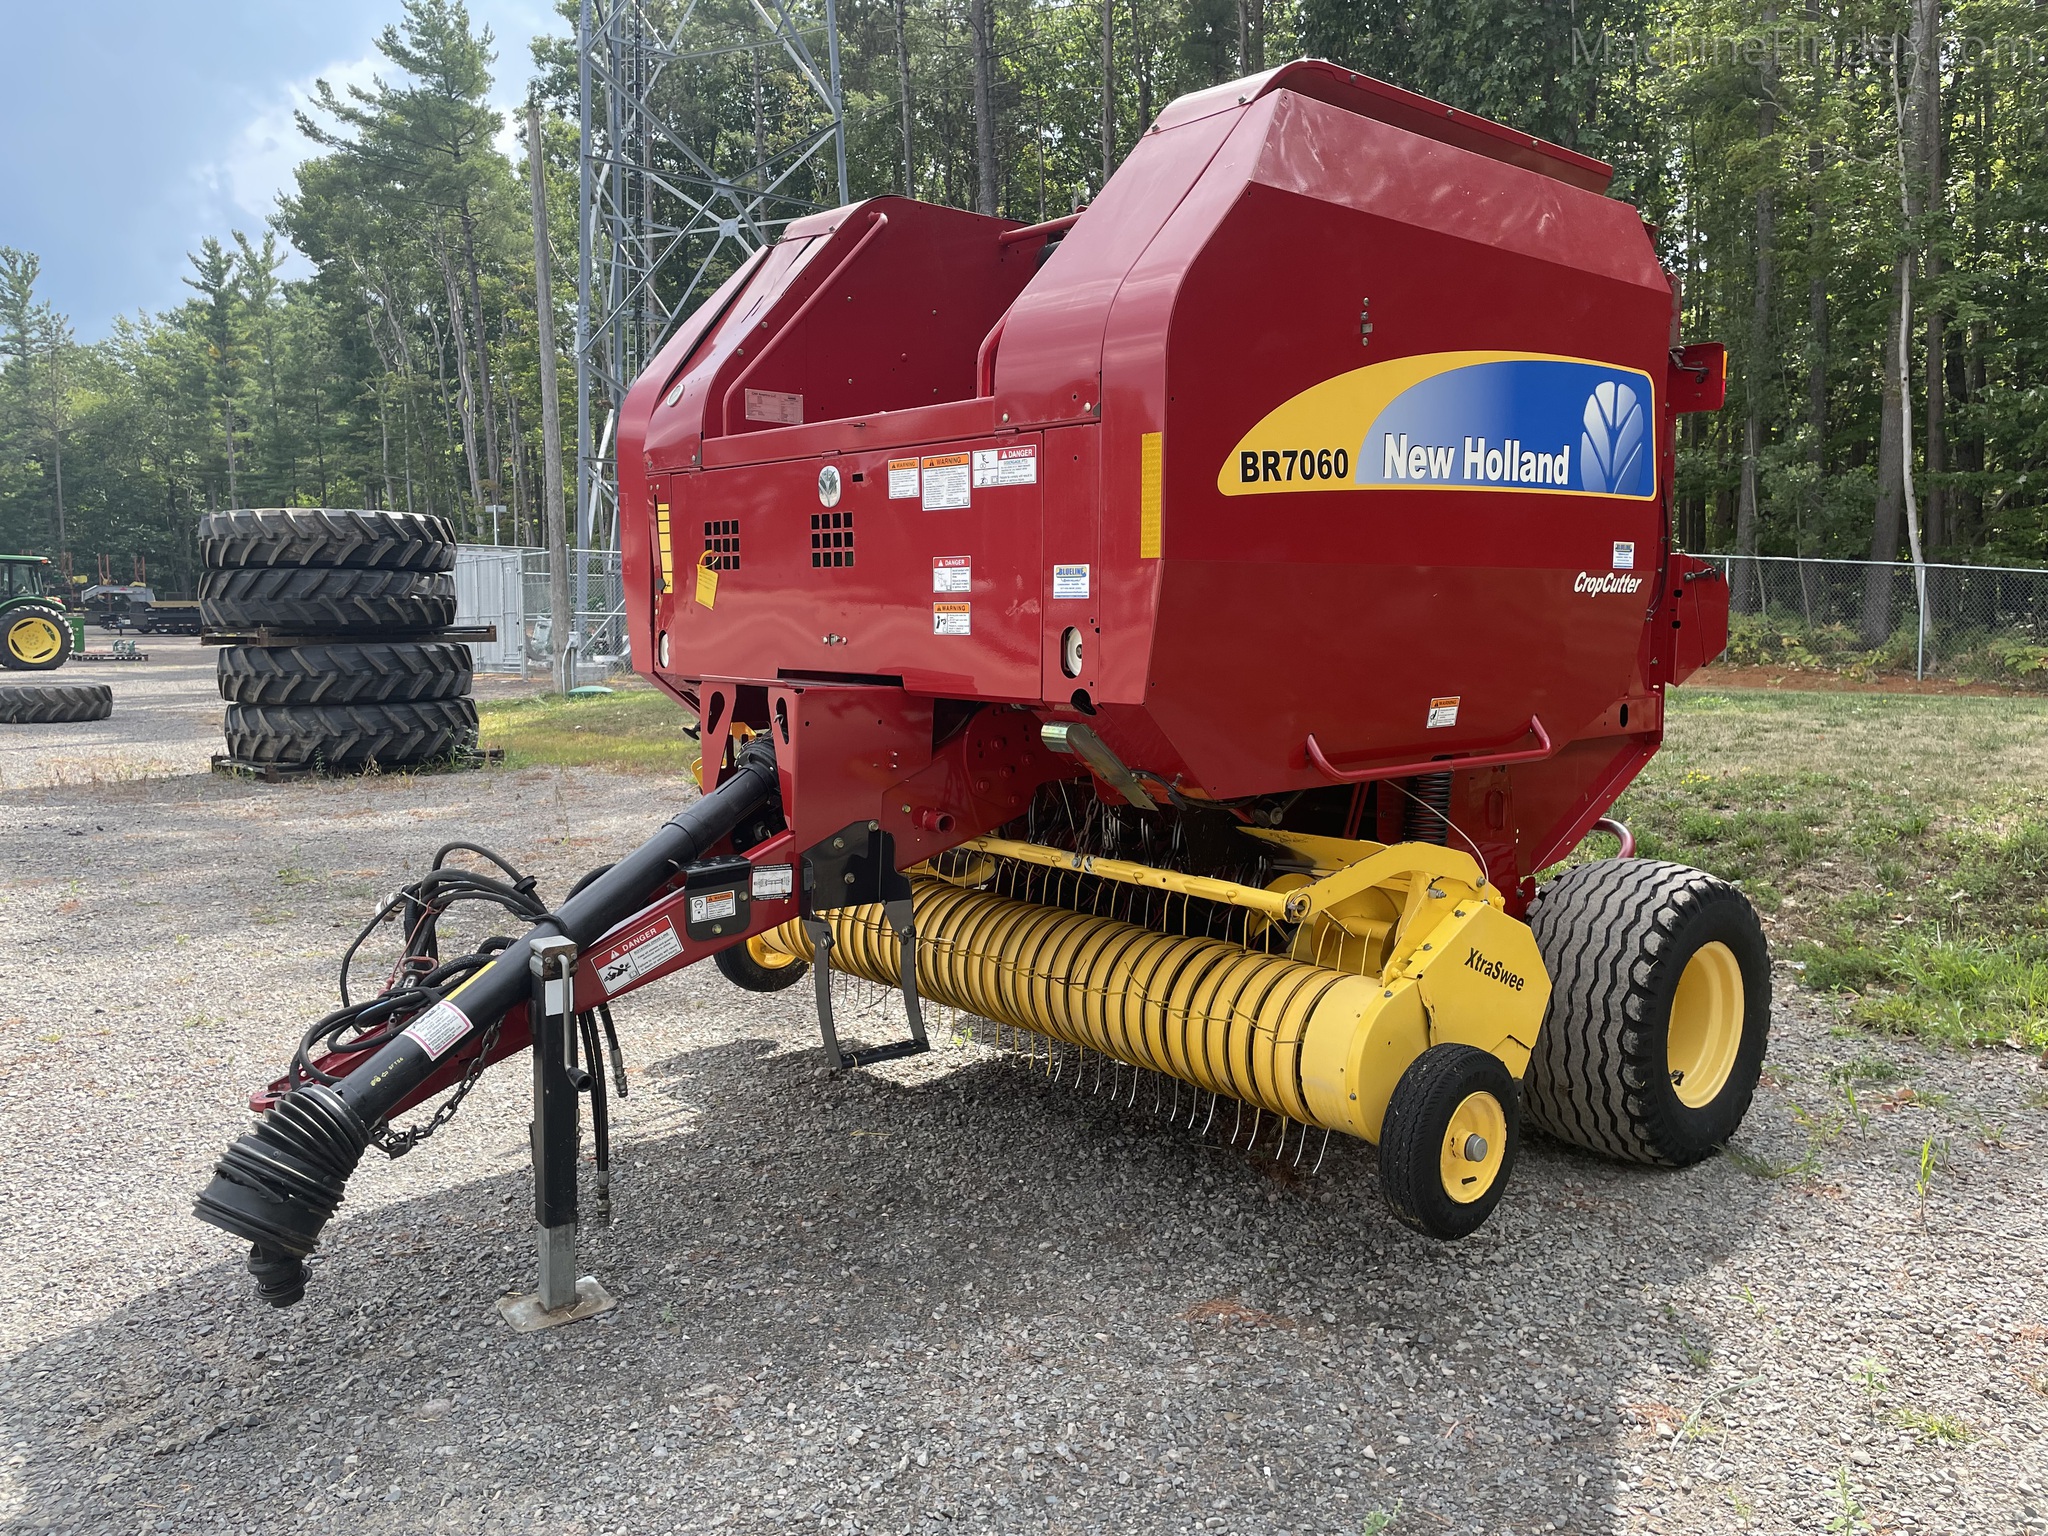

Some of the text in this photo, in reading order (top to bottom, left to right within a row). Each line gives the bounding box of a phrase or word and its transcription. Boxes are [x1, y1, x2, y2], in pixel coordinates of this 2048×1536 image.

[936, 457, 962, 465] WARNING
[1008, 449, 1033, 458] DANGER
[1240, 448, 1349, 483] BR7060
[1382, 432, 1570, 485] New Holland
[1574, 571, 1643, 598] CropCutter
[622, 928, 657, 951] DANGER
[1464, 947, 1524, 991] XtraSwee
